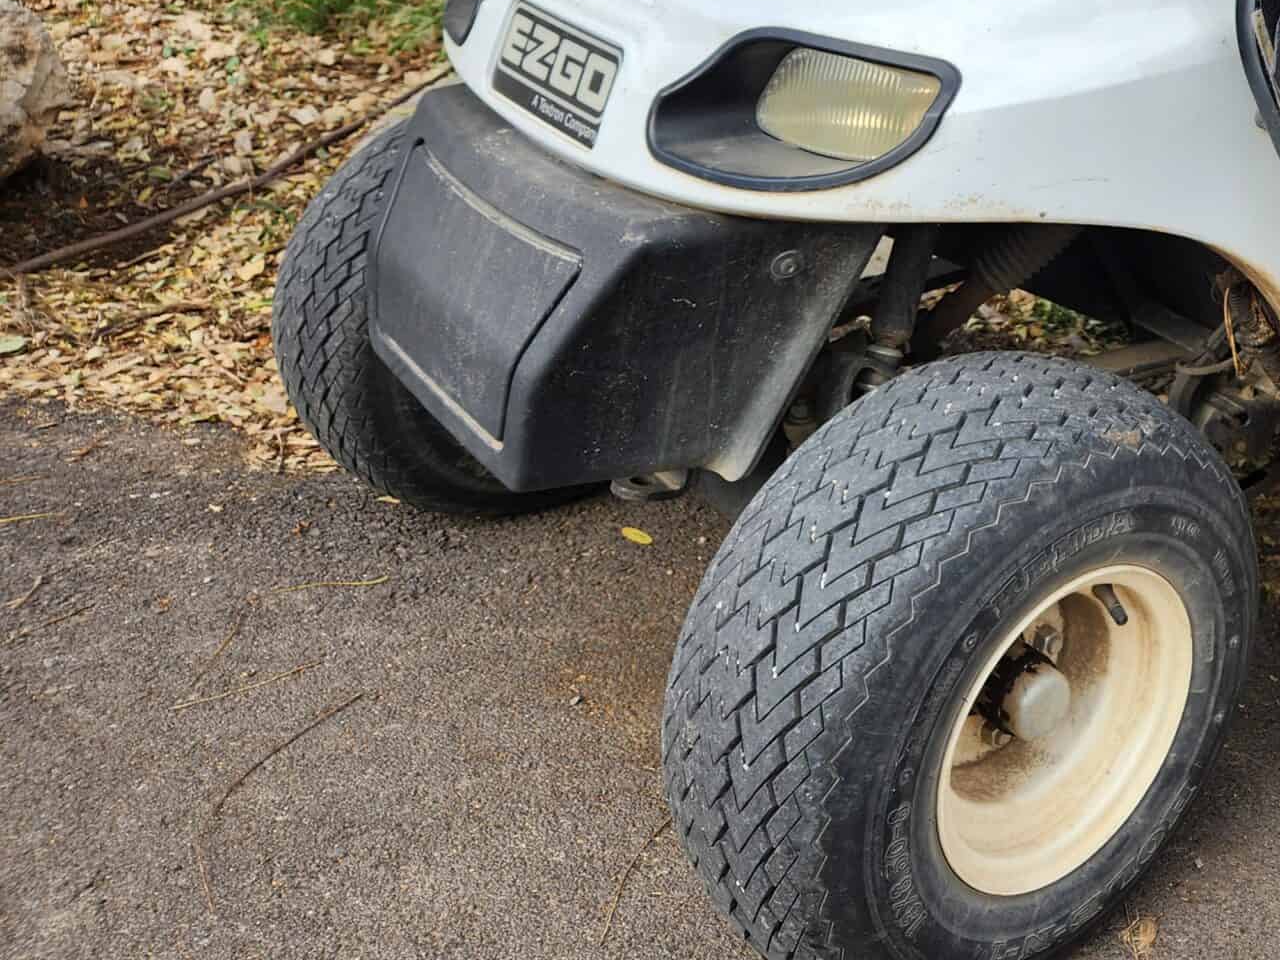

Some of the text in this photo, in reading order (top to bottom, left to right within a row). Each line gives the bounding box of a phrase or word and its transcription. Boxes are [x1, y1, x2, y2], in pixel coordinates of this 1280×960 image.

[501, 12, 618, 113] EZGO
[530, 94, 540, 107] A
[537, 96, 564, 123] Textron
